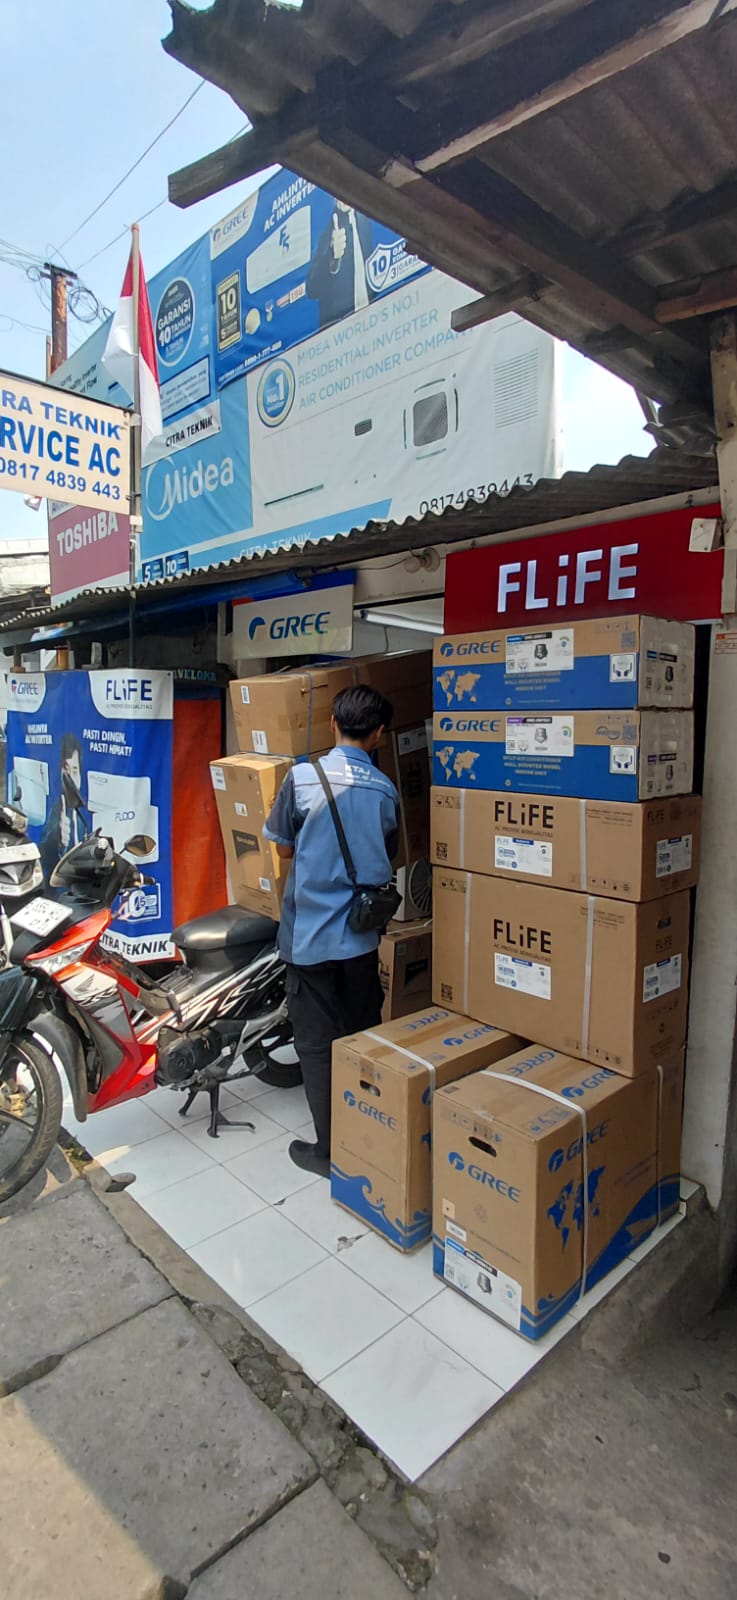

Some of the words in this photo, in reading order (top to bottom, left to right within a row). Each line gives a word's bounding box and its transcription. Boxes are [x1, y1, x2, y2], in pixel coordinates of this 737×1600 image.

[222, 207, 250, 235] GREE
[264, 213, 275, 232] AC
[372, 255, 387, 277] 10
[158, 297, 191, 330] GARANSI
[221, 287, 236, 314] 10
[159, 329, 171, 347] 10
[170, 313, 191, 333] TAHUN
[297, 341, 330, 366] MIDEA
[334, 307, 389, 345] WORLD'S
[392, 290, 420, 316] NO.1
[299, 343, 370, 387] RESIDENTIAL
[372, 308, 438, 352] INVERTER
[299, 389, 318, 409] AIR
[319, 356, 401, 401] CONDITIONER
[404, 328, 475, 362] COMPA
[40, 401, 120, 440] TEKNIK
[165, 428, 186, 448] CITRA
[187, 415, 214, 437] TEKNIK
[88, 442, 120, 477] AC
[46, 470, 86, 492] 4839
[92, 481, 120, 500] 443
[161, 457, 236, 512] Midea
[56, 511, 119, 557] TOSHIBA
[240, 544, 268, 558] CITRA
[144, 565, 151, 582] 5
[166, 559, 176, 576] 10
[269, 611, 331, 640] GREE
[457, 640, 502, 656] GREE
[17, 681, 39, 696] GREE
[83, 728, 100, 740] PASTI
[456, 719, 501, 732] GREE
[90, 742, 108, 753] PASTI
[122, 940, 168, 956] TEKNIK
[404, 1011, 449, 1031] GREE
[506, 1050, 556, 1077] GREE
[358, 1101, 397, 1130] GREE
[566, 1119, 609, 1162] GREE
[468, 1164, 521, 1204] GREE
